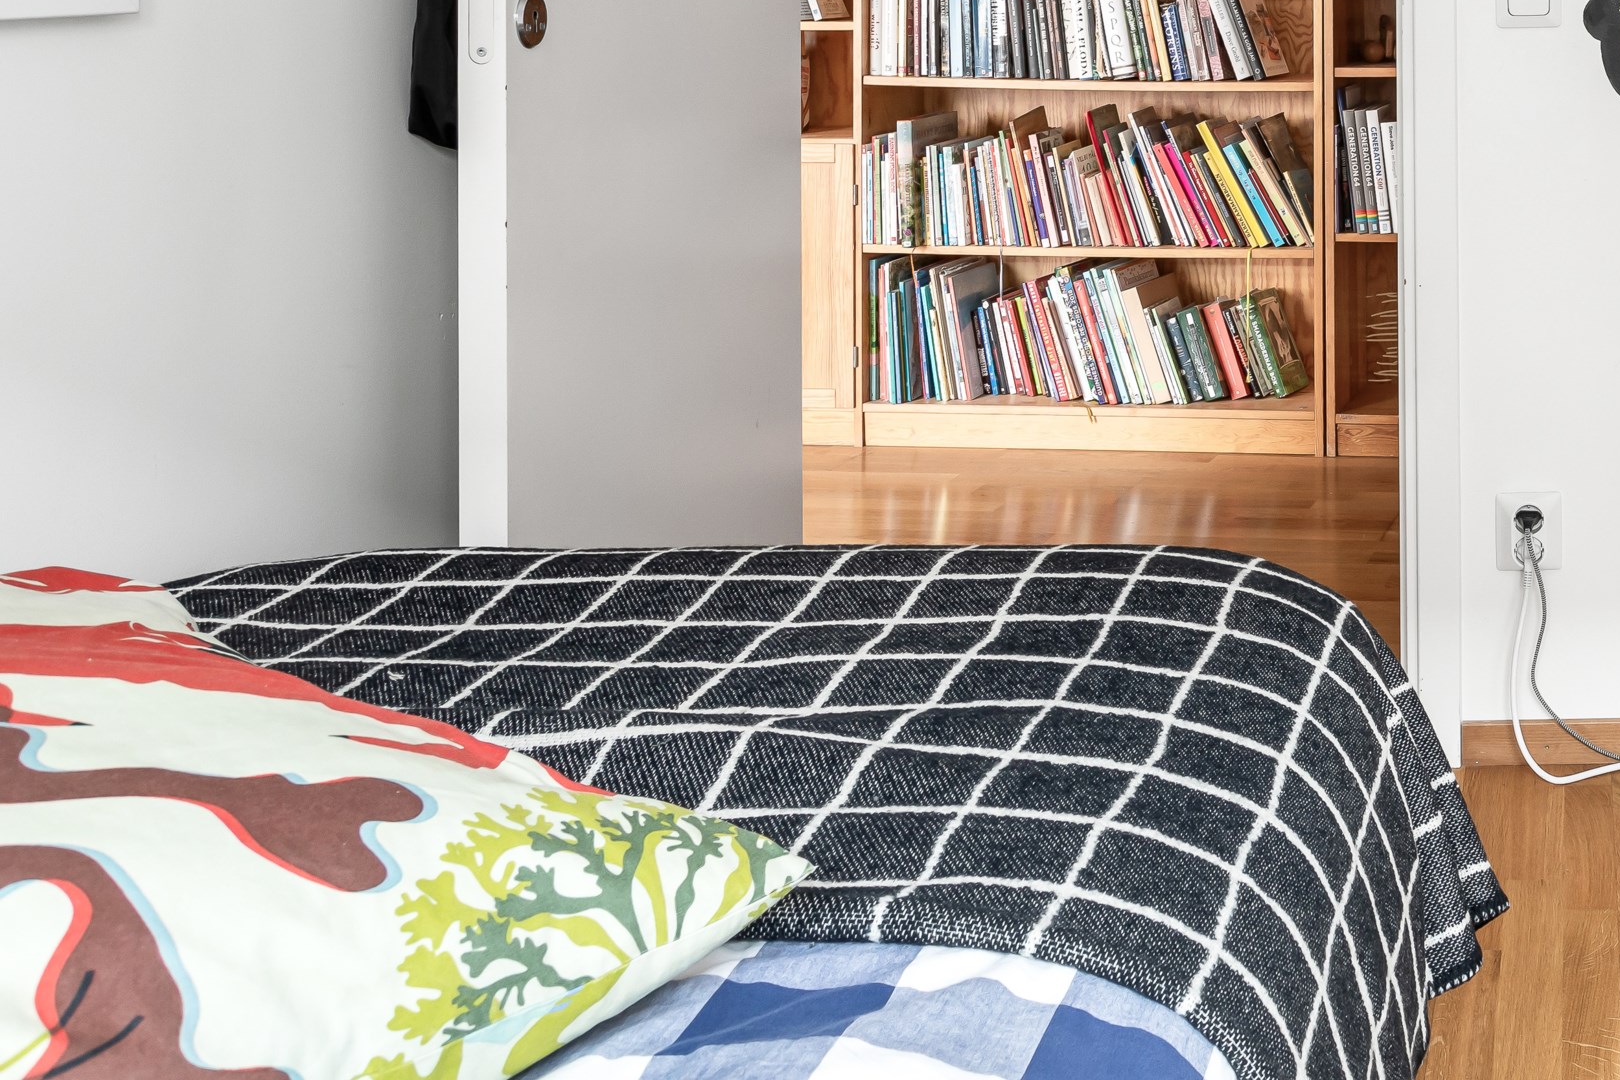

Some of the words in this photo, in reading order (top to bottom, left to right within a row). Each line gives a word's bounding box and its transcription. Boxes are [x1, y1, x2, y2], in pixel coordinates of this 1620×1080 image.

[1347, 126, 1360, 177] GENERATION
[1359, 126, 1373, 177] GENERATION
[1370, 126, 1383, 177] GENERATION
[1214, 173, 1252, 238] BARNKAMMARBOKEN
[1073, 306, 1085, 338] RECORDS
[1087, 362, 1103, 397] GUINNESS
